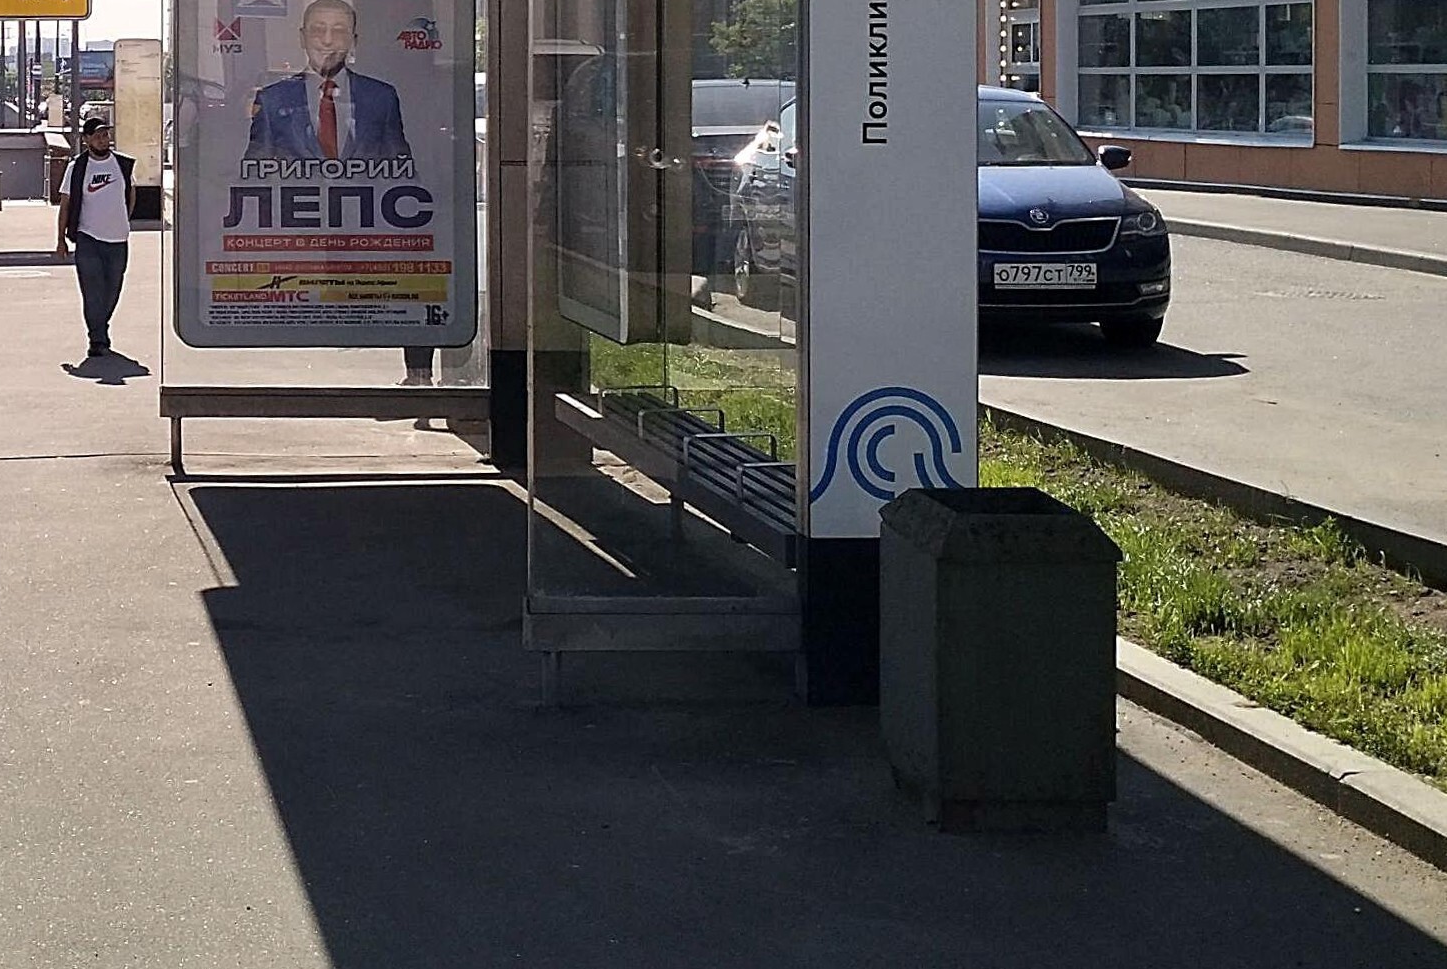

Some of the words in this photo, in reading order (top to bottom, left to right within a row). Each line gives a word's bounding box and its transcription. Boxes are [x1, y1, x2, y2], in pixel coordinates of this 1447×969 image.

[397, 31, 426, 42] АВТО
[404, 40, 442, 50] РАДИО
[241, 155, 416, 180] ГРИГОРИЙ
[91, 173, 112, 184] NIKE
[223, 186, 434, 229] ЛЕПС
[226, 238, 292, 249] КОНЦЕРТ
[296, 238, 306, 248] В
[309, 238, 346, 249] ДЕНЬ
[350, 238, 432, 249] РОЖДЕНИЯ
[998, 265, 1064, 282] О797СТ
[1067, 265, 1092, 277] 799
[270, 290, 310, 302] МТС
[426, 304, 450, 326] 16+
